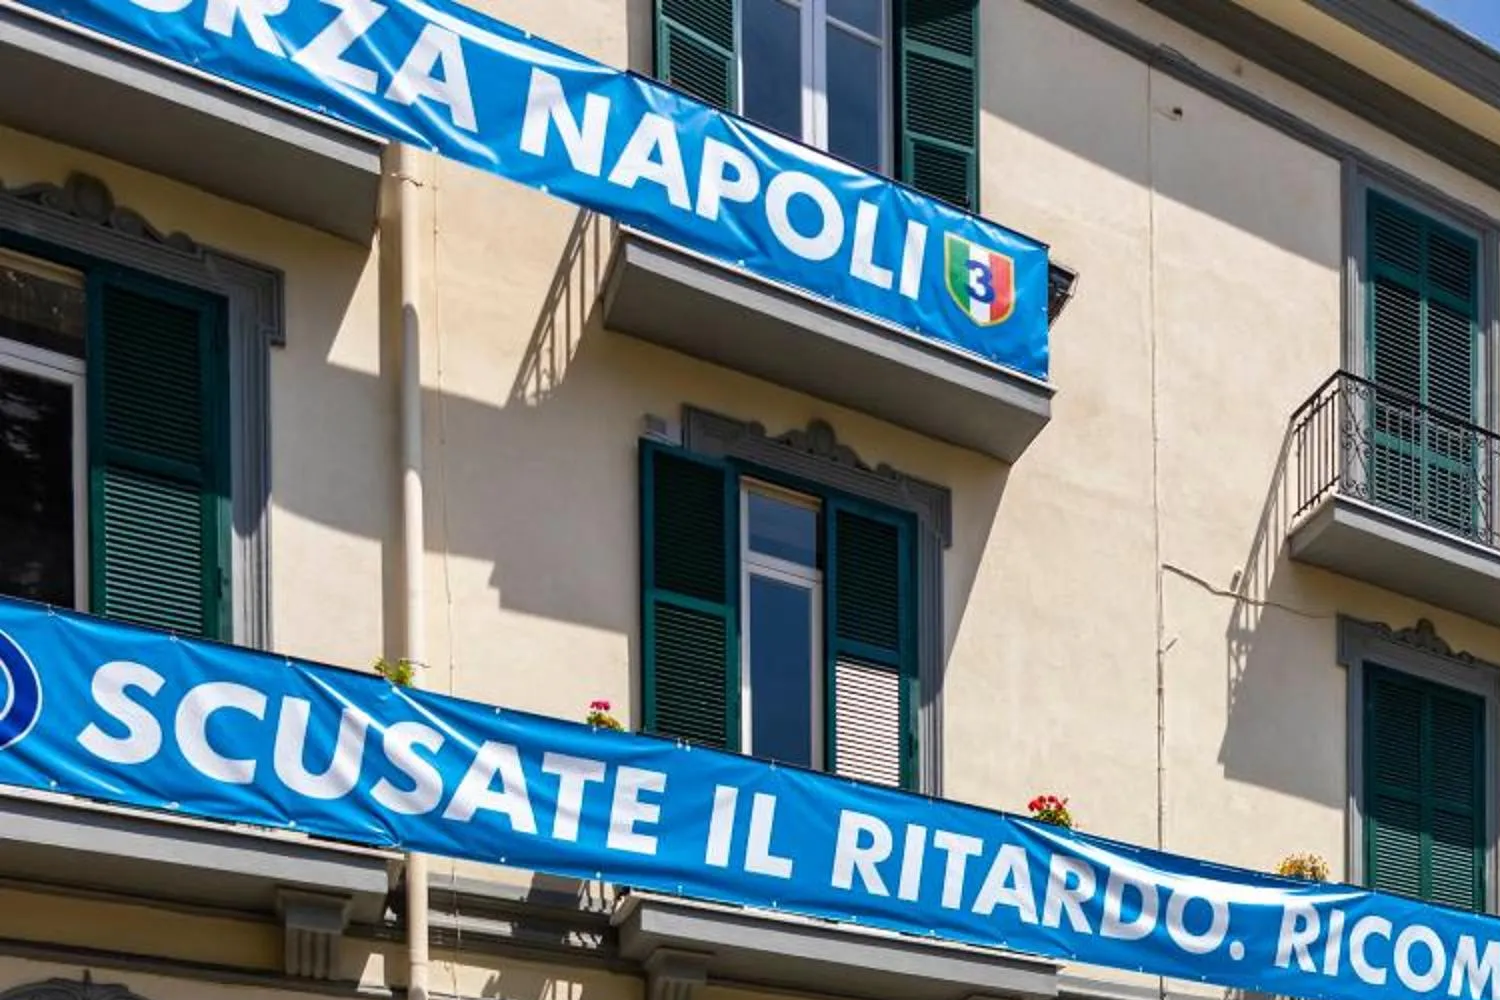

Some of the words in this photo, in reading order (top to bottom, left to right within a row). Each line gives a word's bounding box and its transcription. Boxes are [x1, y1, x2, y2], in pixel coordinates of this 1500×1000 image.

[128, 0, 478, 132] RZA
[519, 67, 928, 300] NAPOLI
[963, 259, 996, 304] 3
[77, 660, 668, 855] SCUSATE
[705, 785, 793, 879] IL
[831, 808, 1245, 961] RITARDO.
